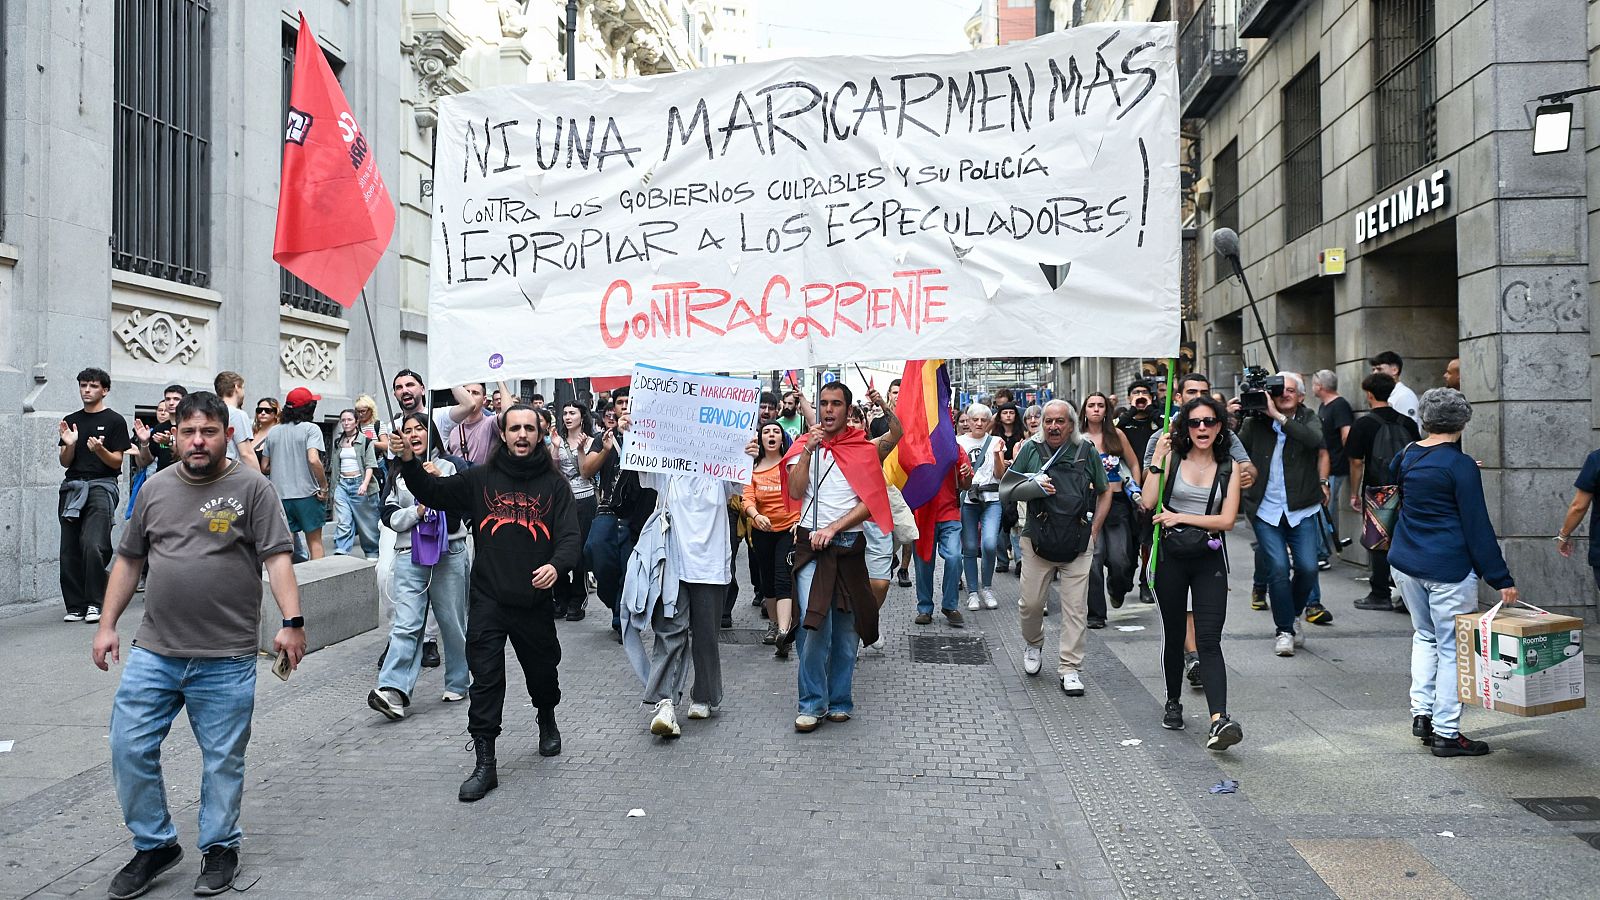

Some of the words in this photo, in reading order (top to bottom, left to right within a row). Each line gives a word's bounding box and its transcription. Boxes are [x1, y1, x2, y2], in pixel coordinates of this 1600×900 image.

[464, 116, 521, 183] NI
[536, 115, 642, 172] UNA
[663, 61, 1036, 161] MARICARMEN
[1049, 30, 1157, 121] MÁS
[462, 197, 541, 225] CONTRA
[554, 196, 603, 219] LOS
[619, 179, 755, 210] GOBIERNOS
[767, 166, 886, 200] CULPABLES
[896, 166, 911, 188] Y
[916, 165, 951, 185] SU
[959, 144, 1050, 183] POLICÍA
[1355, 169, 1446, 244] DECIMAS
[697, 228, 726, 251] A
[740, 212, 812, 254] LOS
[599, 268, 949, 349] CONTRACORRIENTE
[682, 381, 699, 397] DE
[659, 422, 693, 436] FAMILIAS
[709, 441, 737, 454] CALLE
[625, 453, 658, 468] FONDO
[703, 462, 746, 481] MOSAIC
[199, 497, 224, 513] SURF
[227, 497, 245, 517] CLUB
[1522, 635, 1548, 645] Roomba
[1458, 618, 1475, 700] Roomba
[1569, 685, 1581, 695] 115
